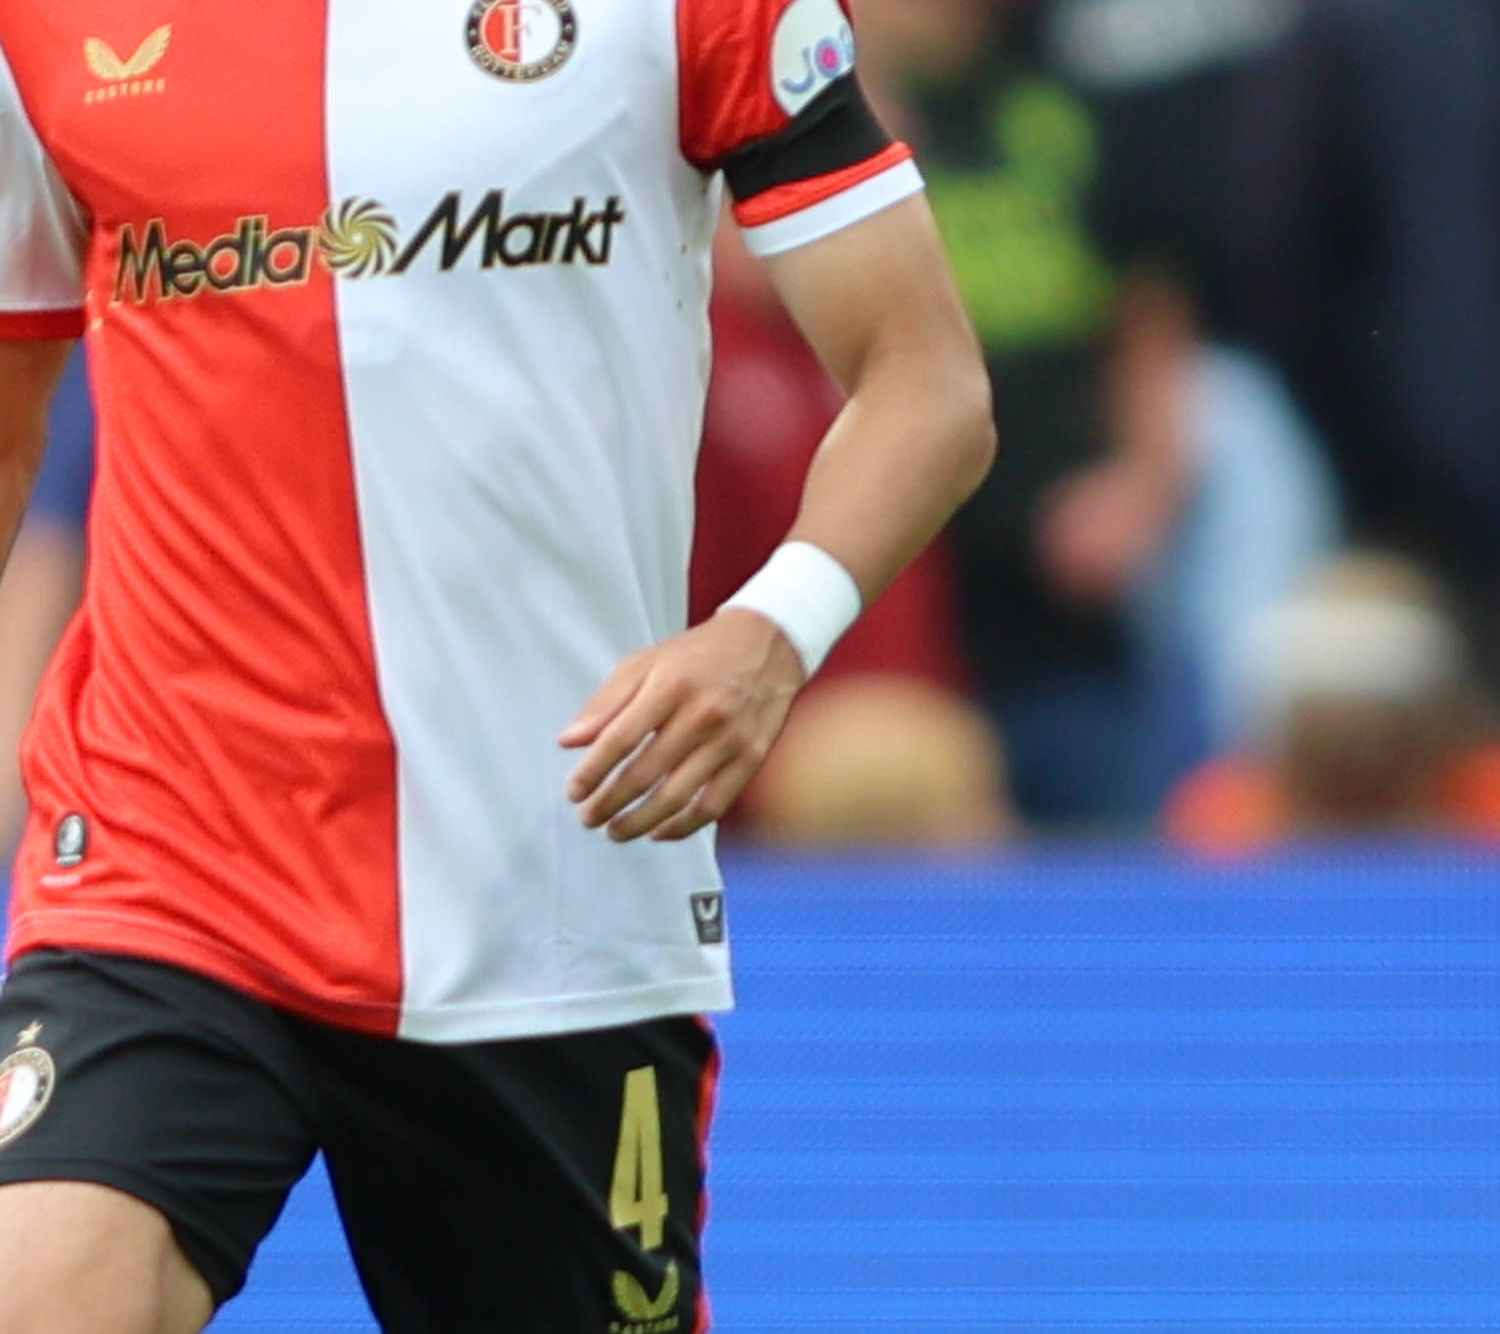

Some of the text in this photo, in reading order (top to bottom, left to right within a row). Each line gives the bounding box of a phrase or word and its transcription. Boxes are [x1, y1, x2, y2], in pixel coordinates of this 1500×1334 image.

[114, 190, 623, 303] Media Markt
[610, 1065, 669, 1252] 4
